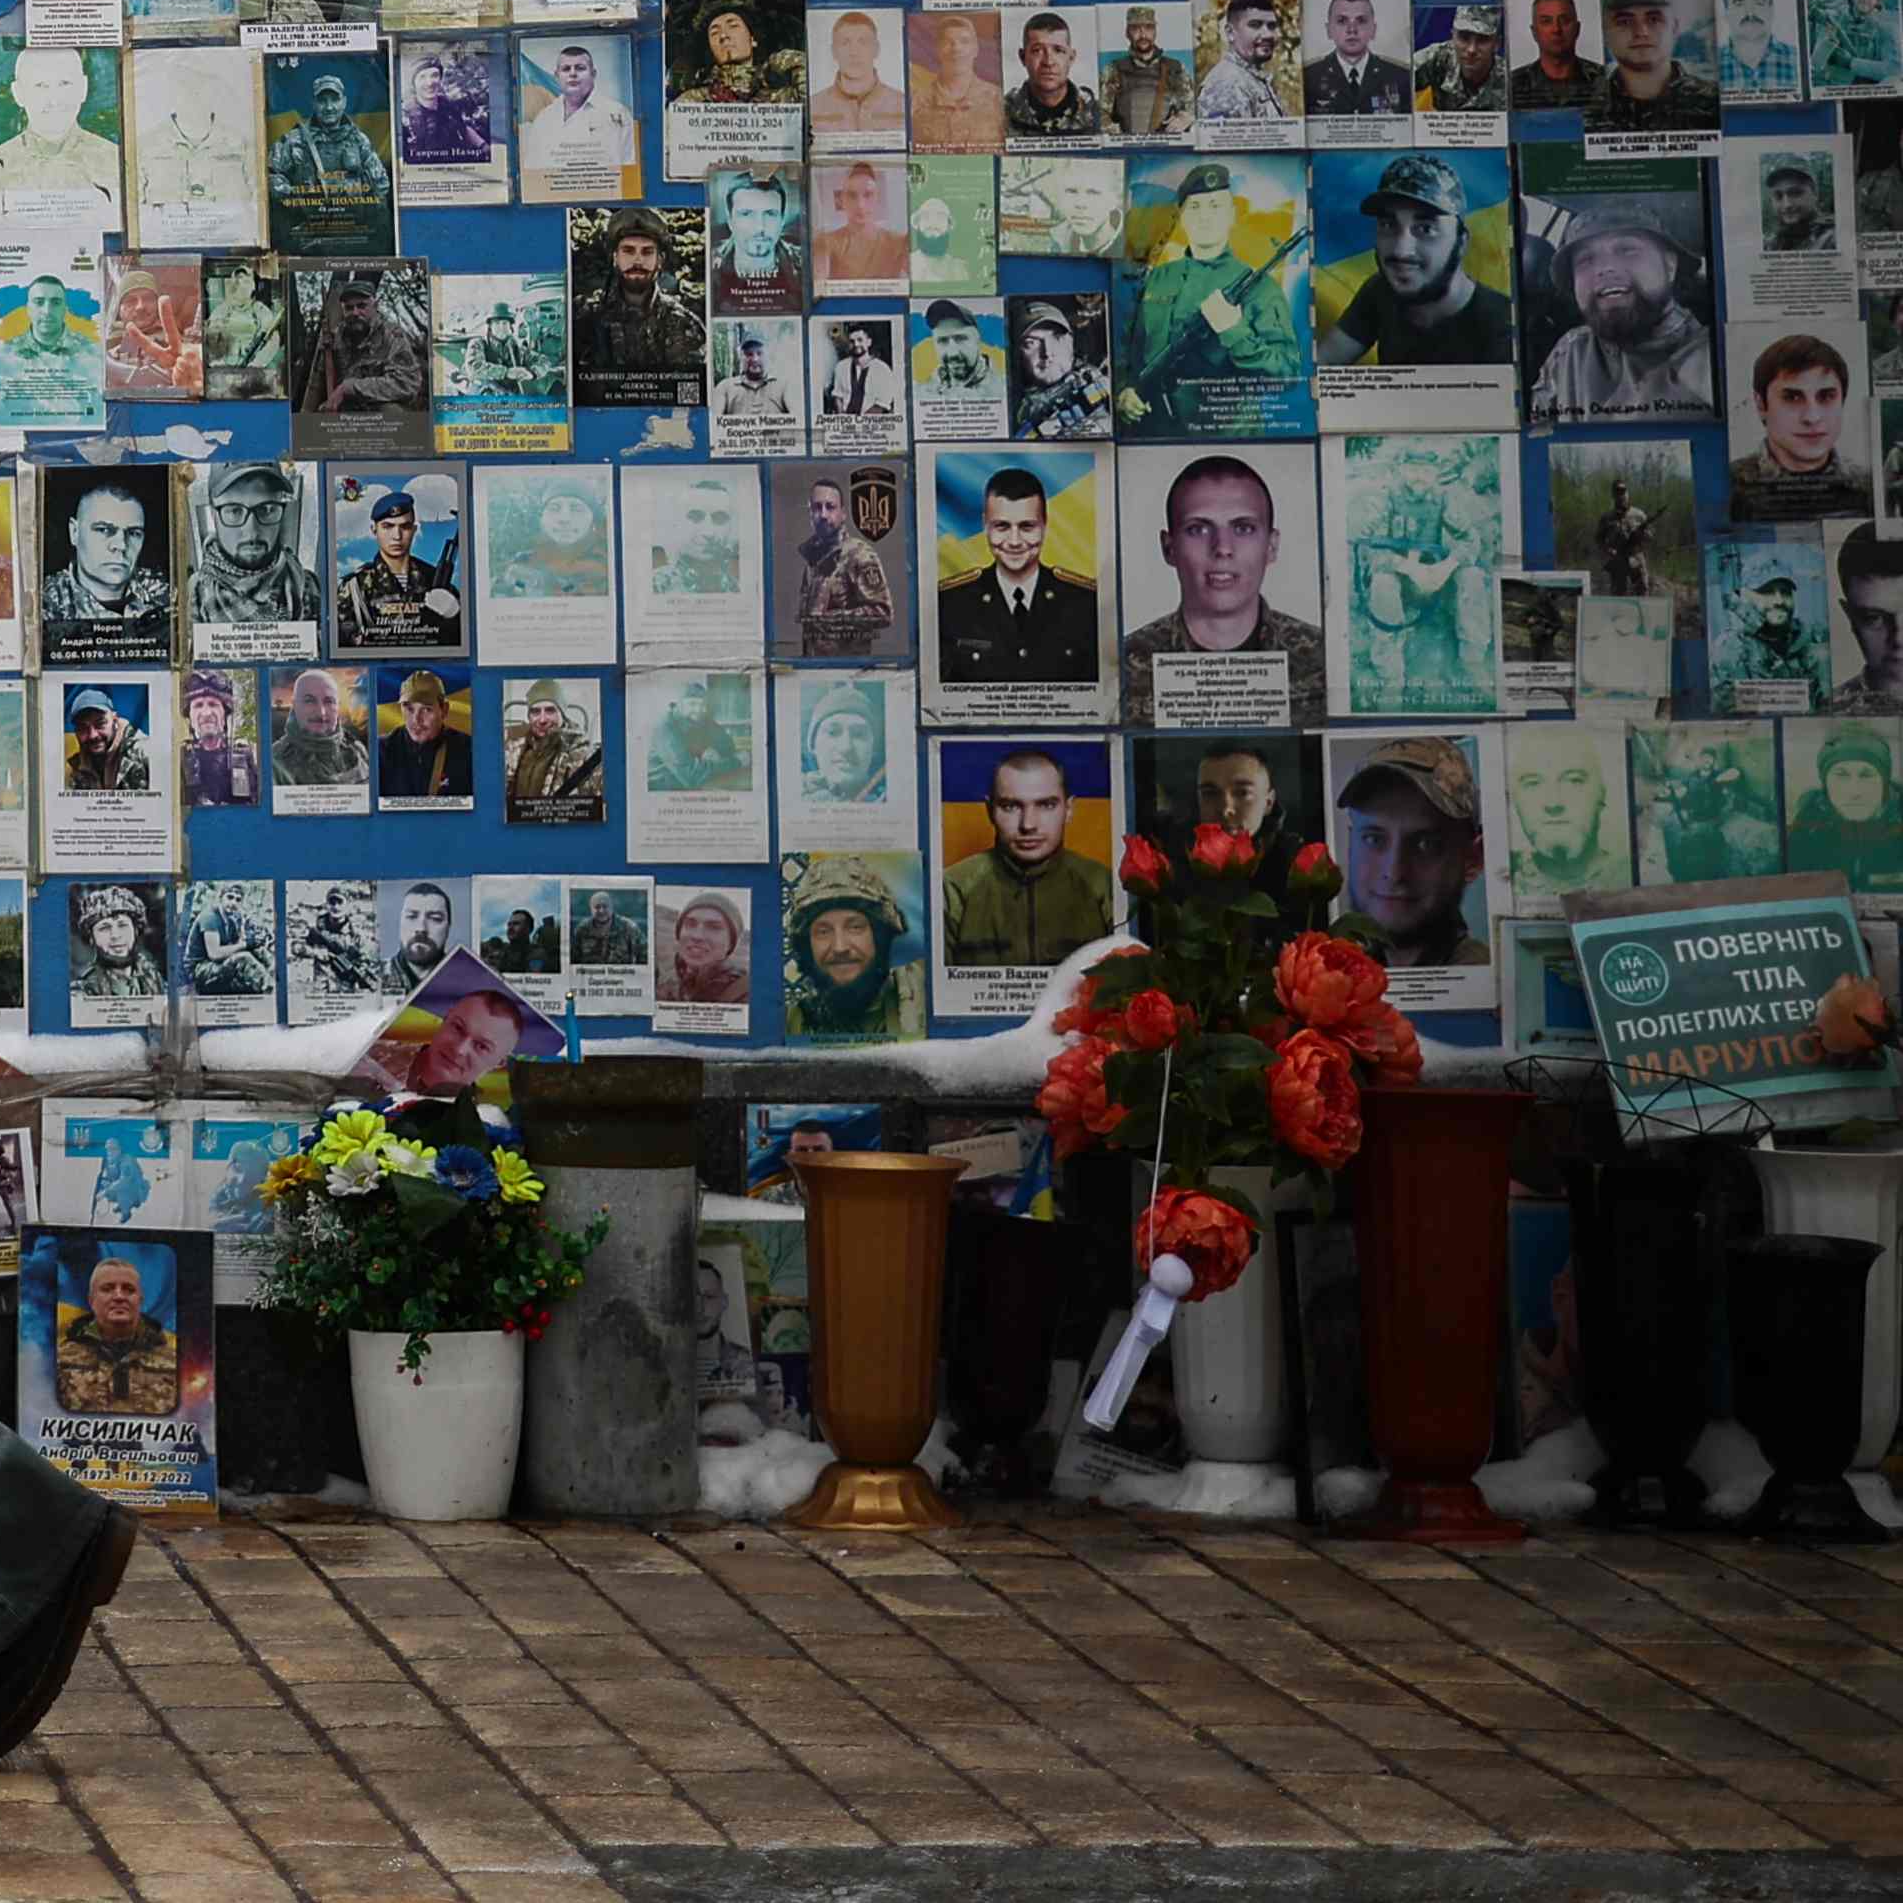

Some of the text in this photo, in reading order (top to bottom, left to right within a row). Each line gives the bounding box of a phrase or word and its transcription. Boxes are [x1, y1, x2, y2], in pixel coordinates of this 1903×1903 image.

[1673, 926, 1842, 963] ПОВЕРНІТЬ
[1619, 956, 1643, 970] НА
[1615, 976, 1659, 995] ЩИТІ
[1733, 966, 1806, 993] ТІЛА
[1616, 998, 1823, 1043] ПОЛЕГЛИХ ГЕР
[1626, 1032, 1823, 1086] МАРІУПО
[41, 1419, 195, 1443] КИСИЛИЧАК
[39, 1447, 198, 1464] Андрій Васильович
